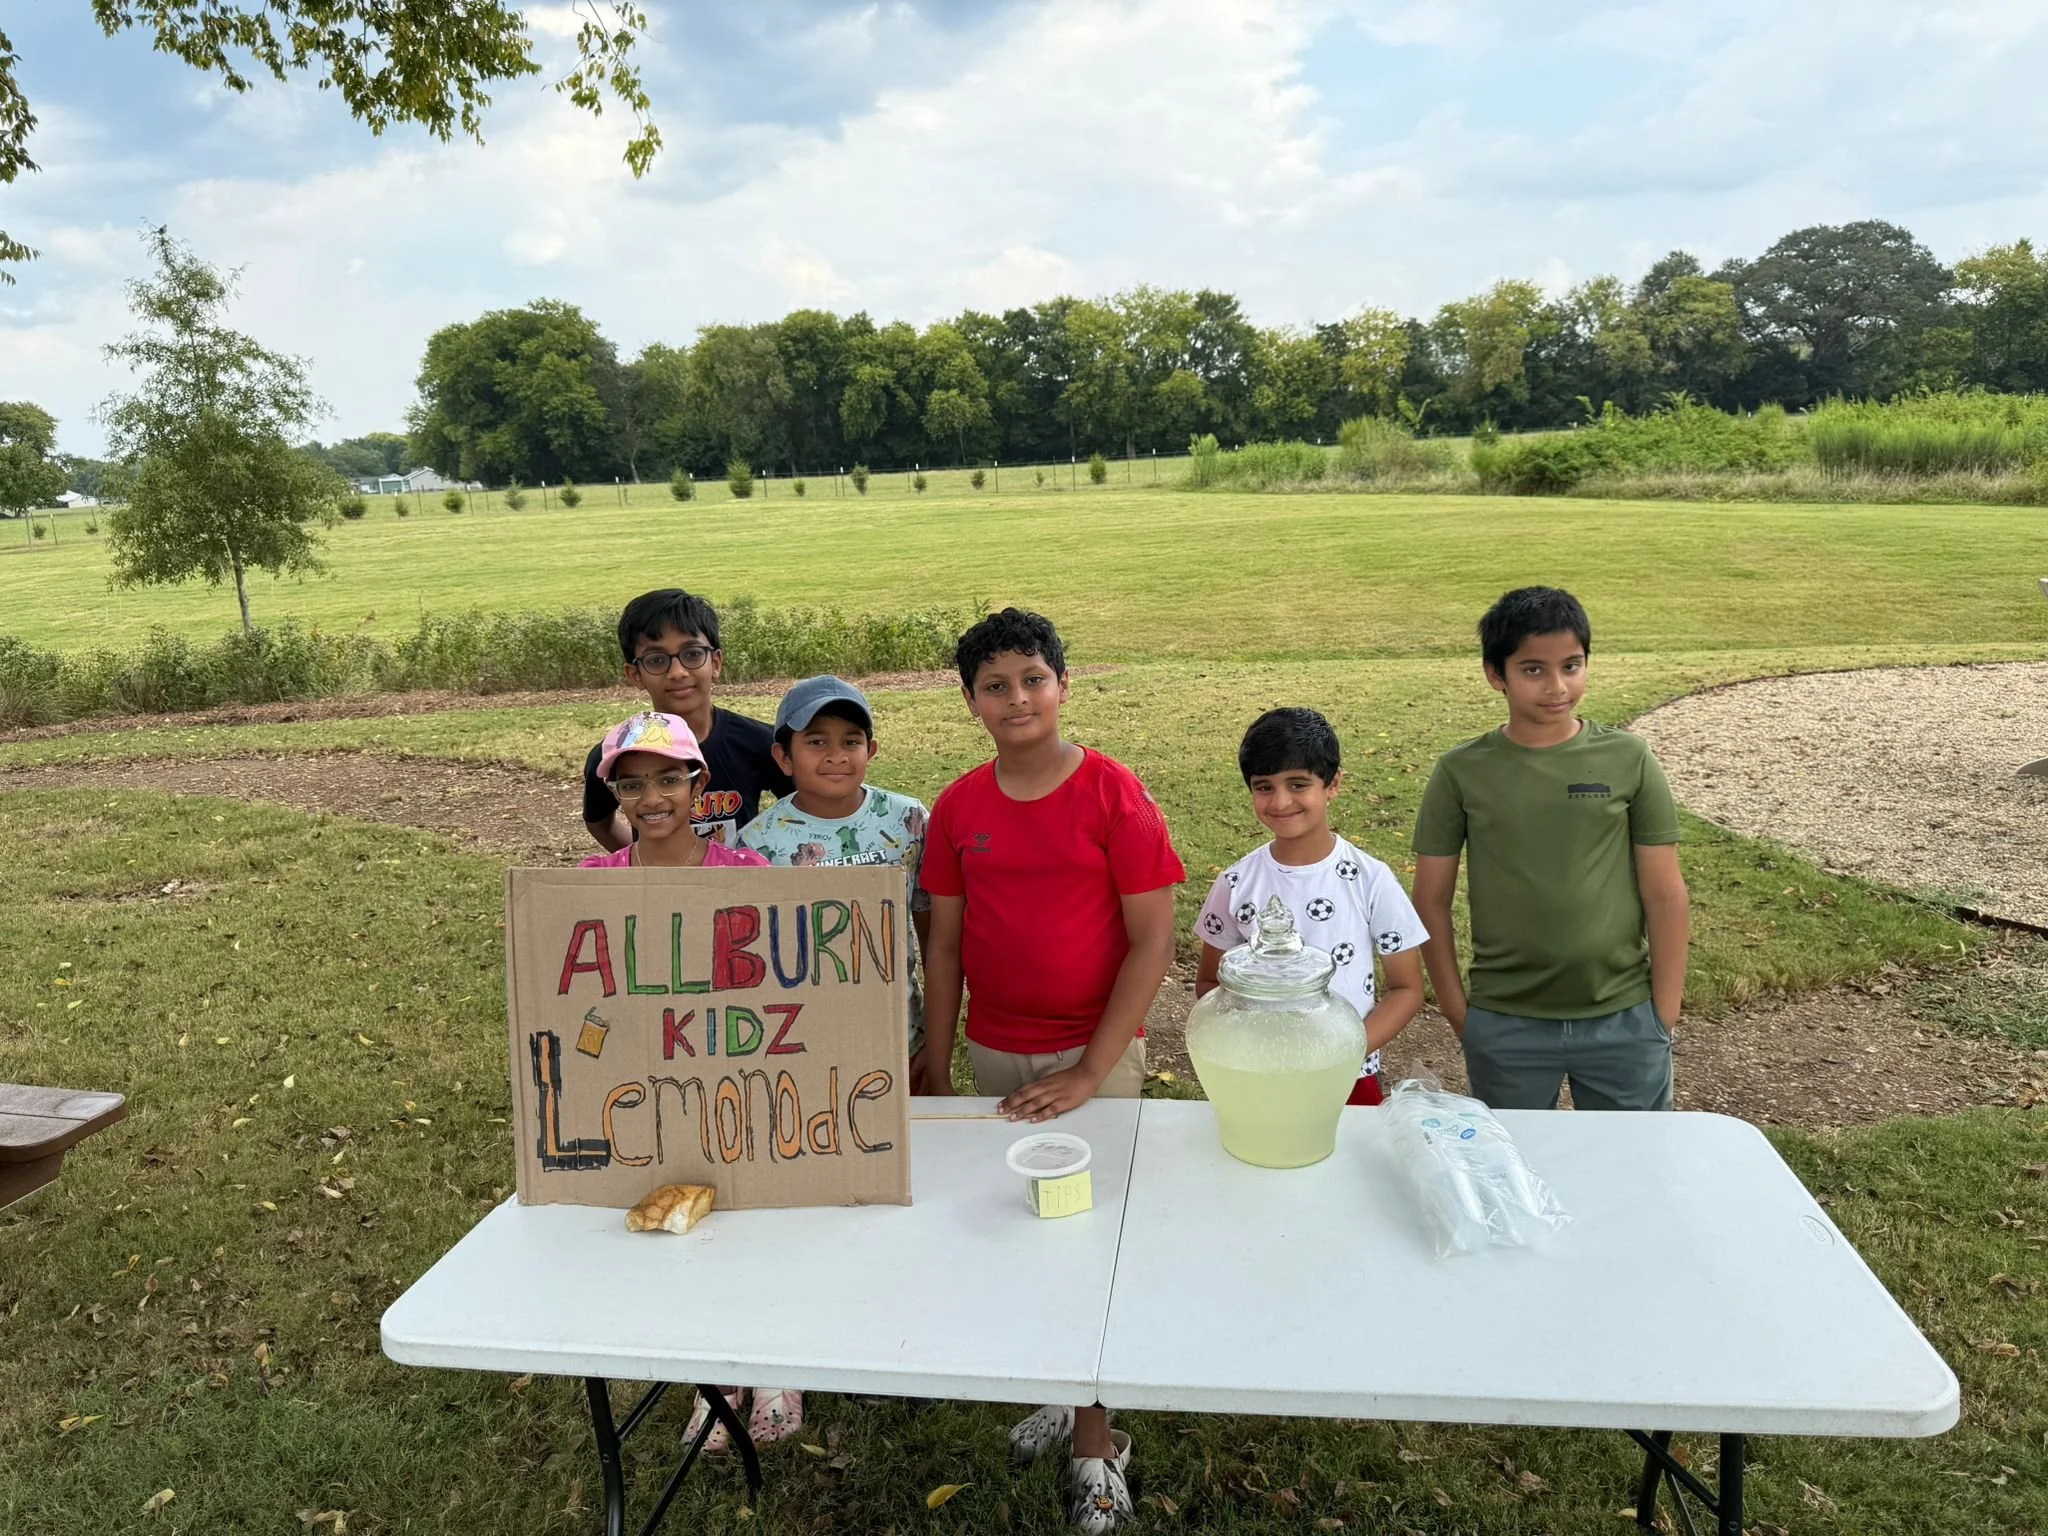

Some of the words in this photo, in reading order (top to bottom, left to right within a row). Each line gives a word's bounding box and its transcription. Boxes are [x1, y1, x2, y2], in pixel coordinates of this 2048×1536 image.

[557, 899, 896, 998] ALLBURN
[662, 1003, 806, 1060] KIDZ
[529, 1029, 893, 1172] Lemonade
